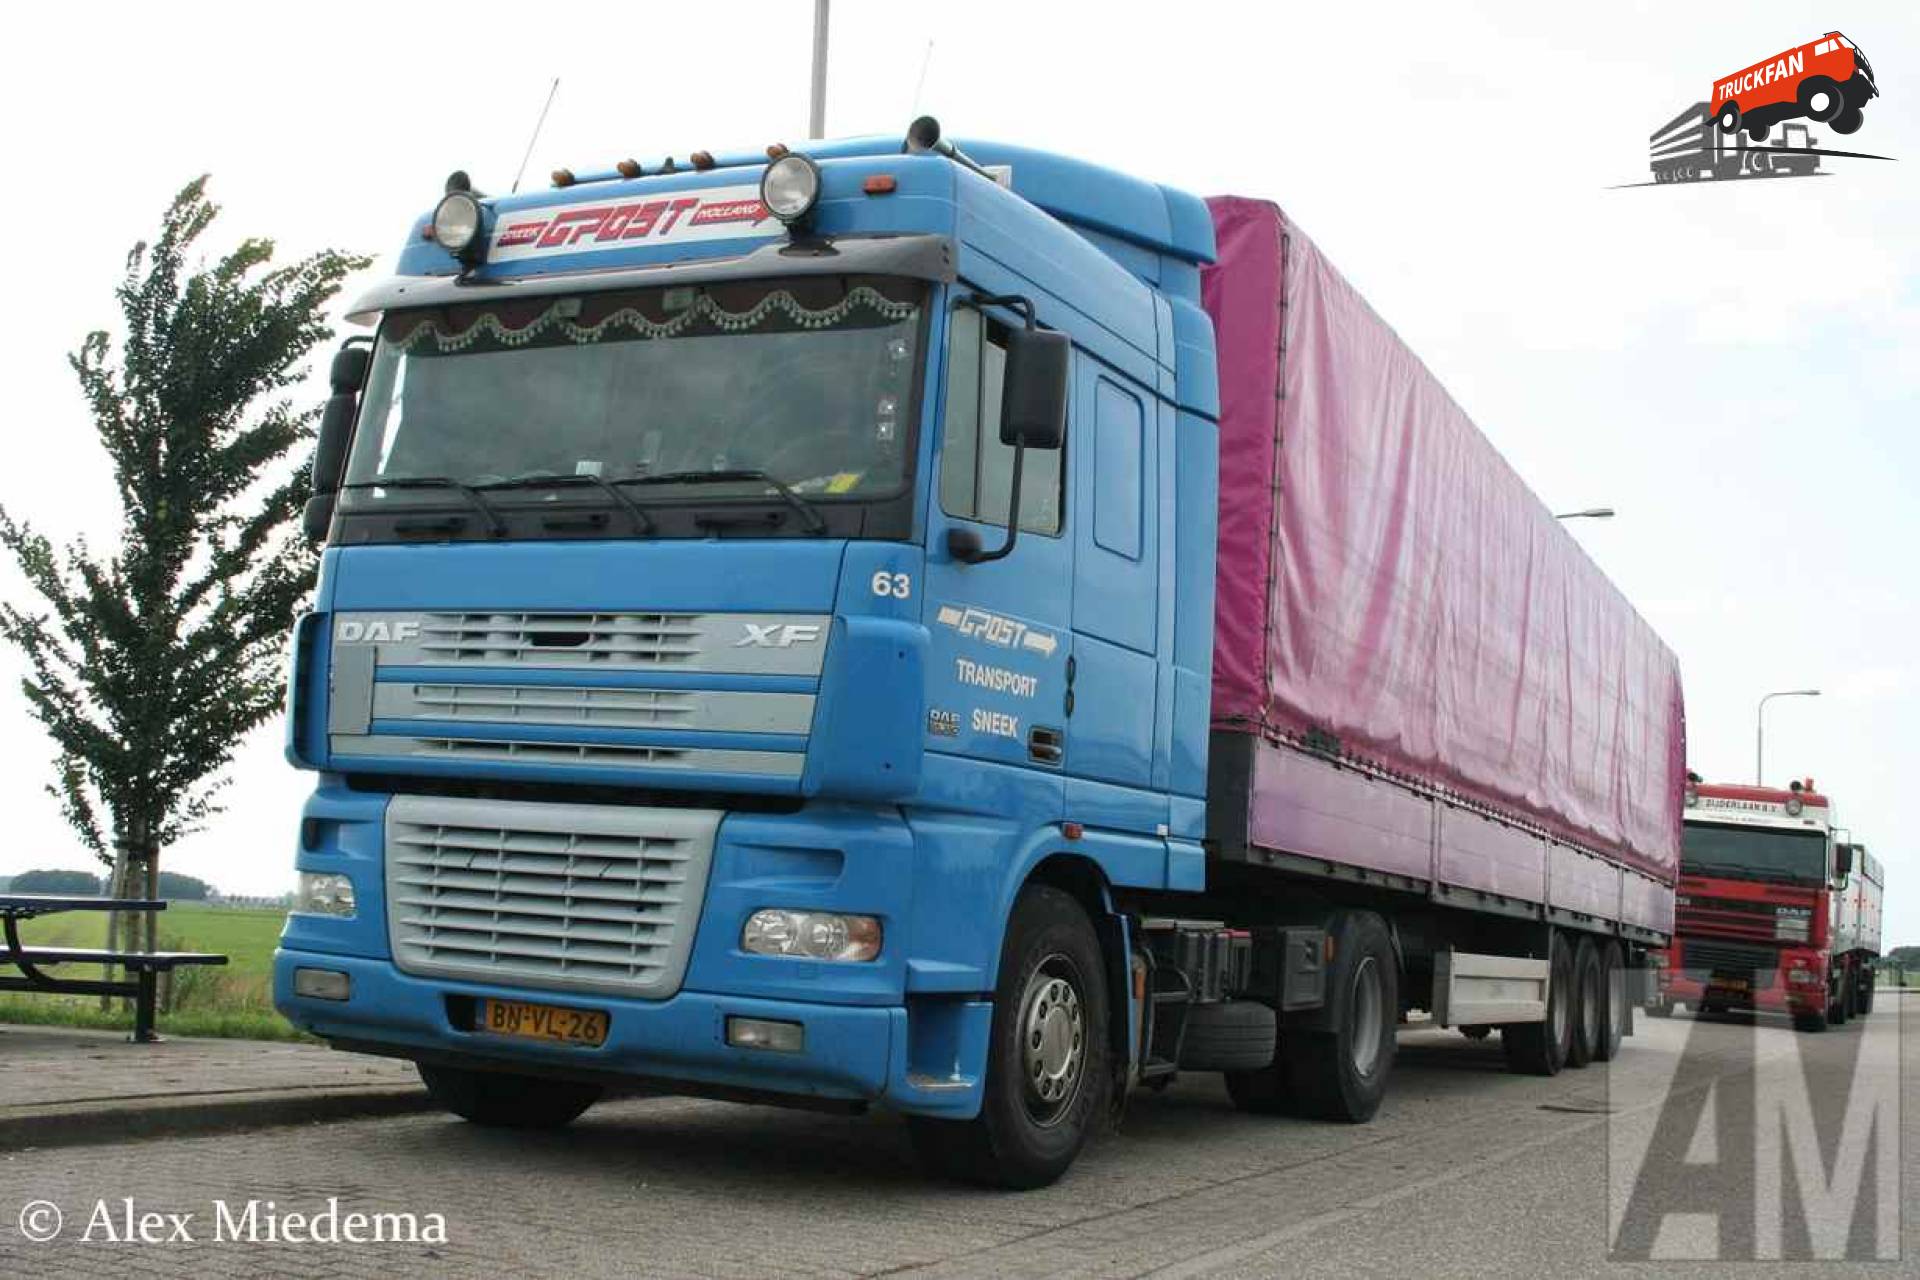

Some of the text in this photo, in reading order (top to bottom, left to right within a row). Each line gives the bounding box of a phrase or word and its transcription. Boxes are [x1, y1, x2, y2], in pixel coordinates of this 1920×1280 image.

[872, 571, 911, 599] 63
[337, 621, 420, 642] DAF
[736, 623, 820, 649] XF
[956, 658, 1038, 698] TRANSPORT
[972, 707, 1019, 738] SNEEK
[493, 1001, 599, 1040] BN-VL-26
